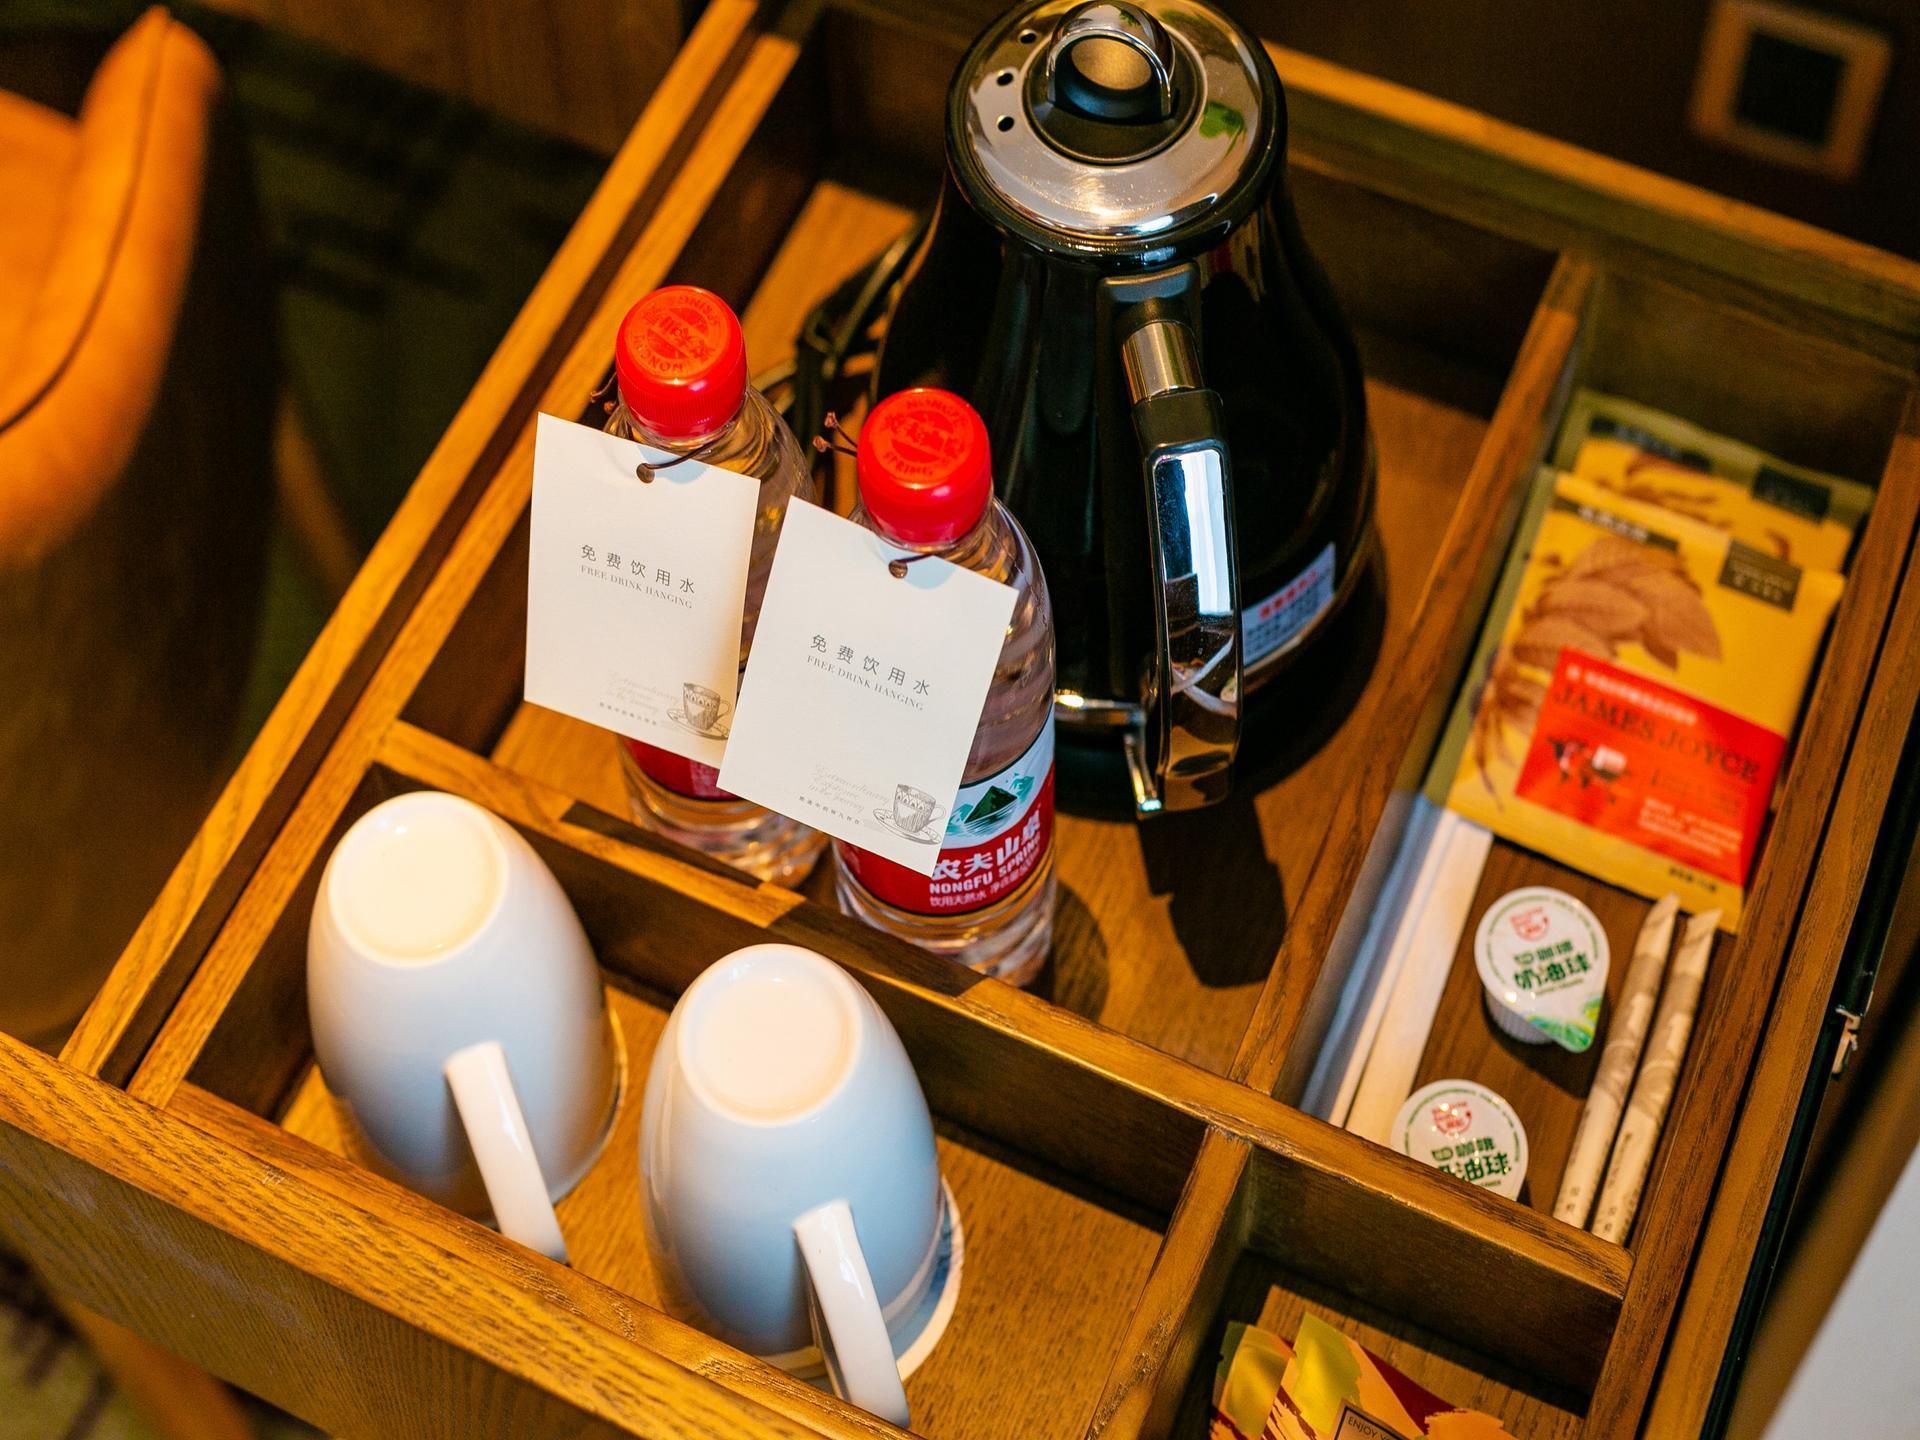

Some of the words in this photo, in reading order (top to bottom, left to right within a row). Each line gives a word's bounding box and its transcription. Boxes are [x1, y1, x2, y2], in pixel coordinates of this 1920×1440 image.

[581, 544, 695, 594] 免费饮用水
[581, 565, 607, 580] FREE
[610, 575, 642, 592] DRINK
[646, 587, 693, 609] HANGING
[807, 655, 834, 674] FREE
[838, 667, 871, 689] DRINK
[874, 683, 924, 711] HANGING
[810, 634, 931, 696] 免费饮用水
[929, 871, 993, 895] NONGFU
[1348, 1416, 1378, 1438] ENJOY
